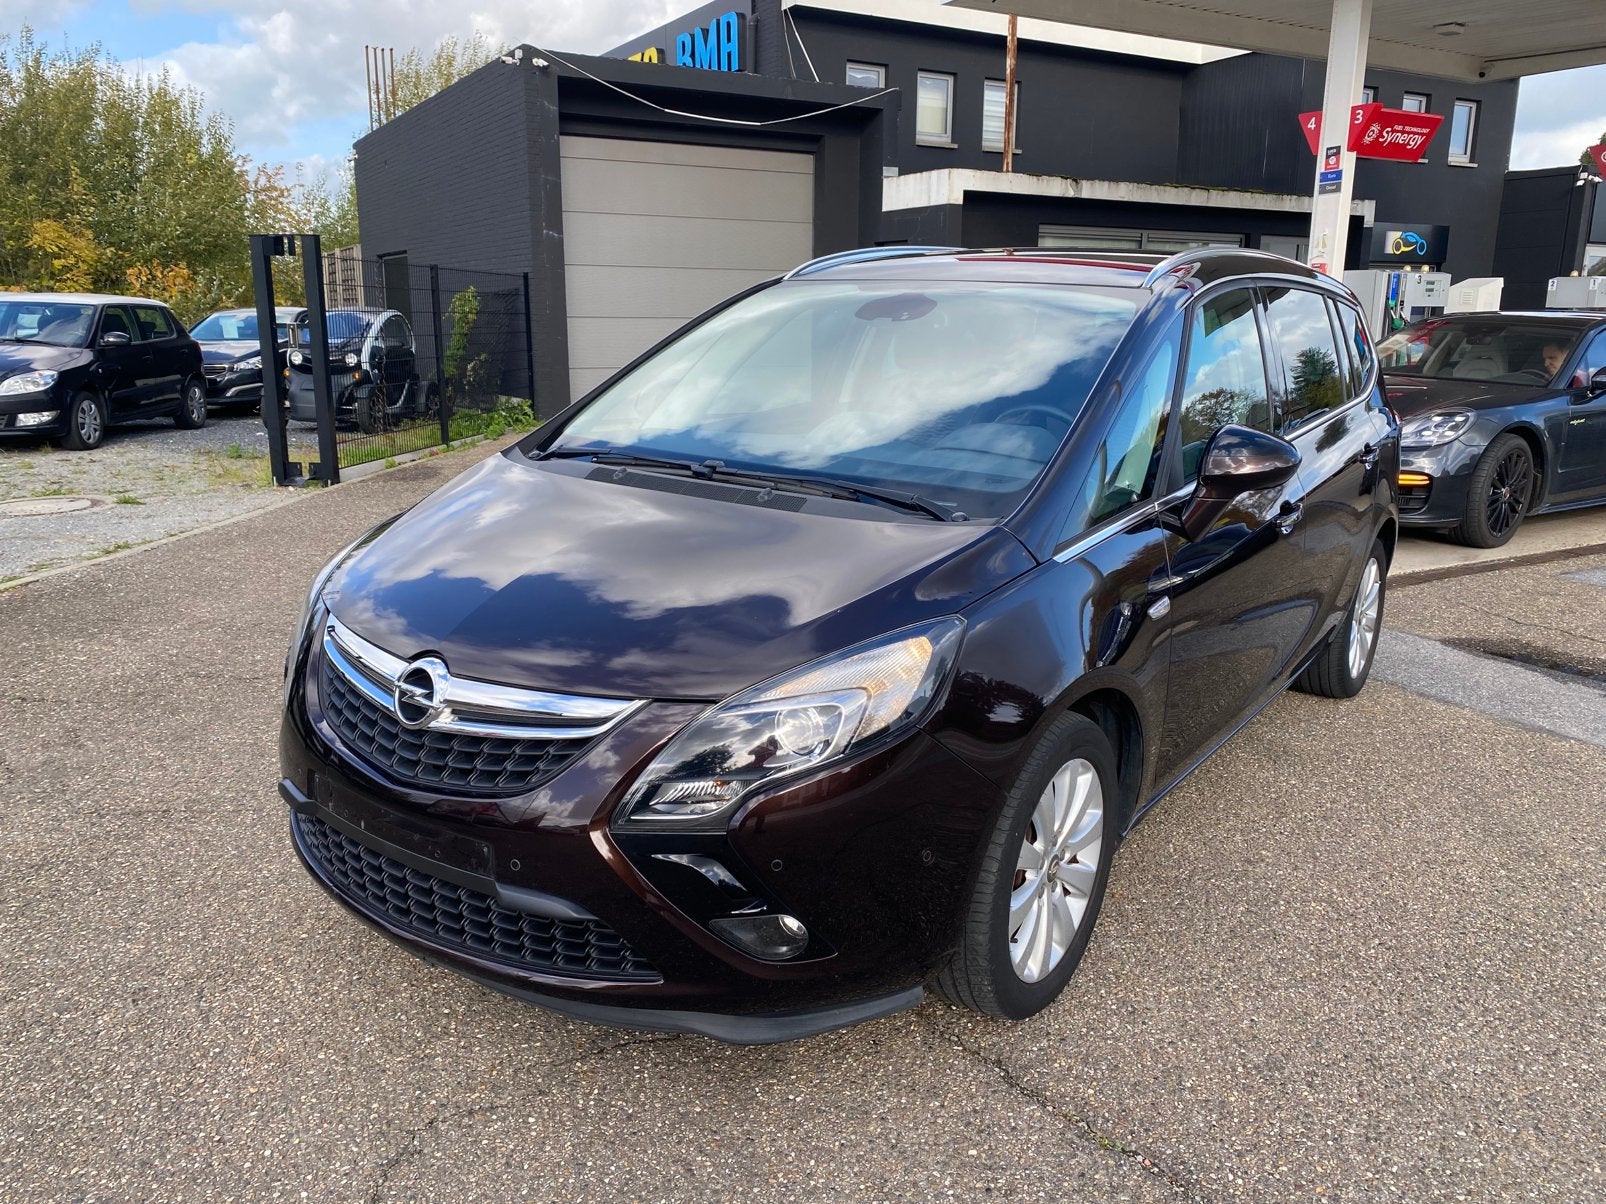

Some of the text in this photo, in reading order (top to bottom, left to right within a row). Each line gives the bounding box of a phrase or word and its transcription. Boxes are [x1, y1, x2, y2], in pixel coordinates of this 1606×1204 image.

[676, 12, 739, 71] BMA
[1307, 117, 1316, 130] 4
[1354, 109, 1363, 124] 3
[1379, 127, 1426, 149] Synergy
[1417, 275, 1422, 284] 3
